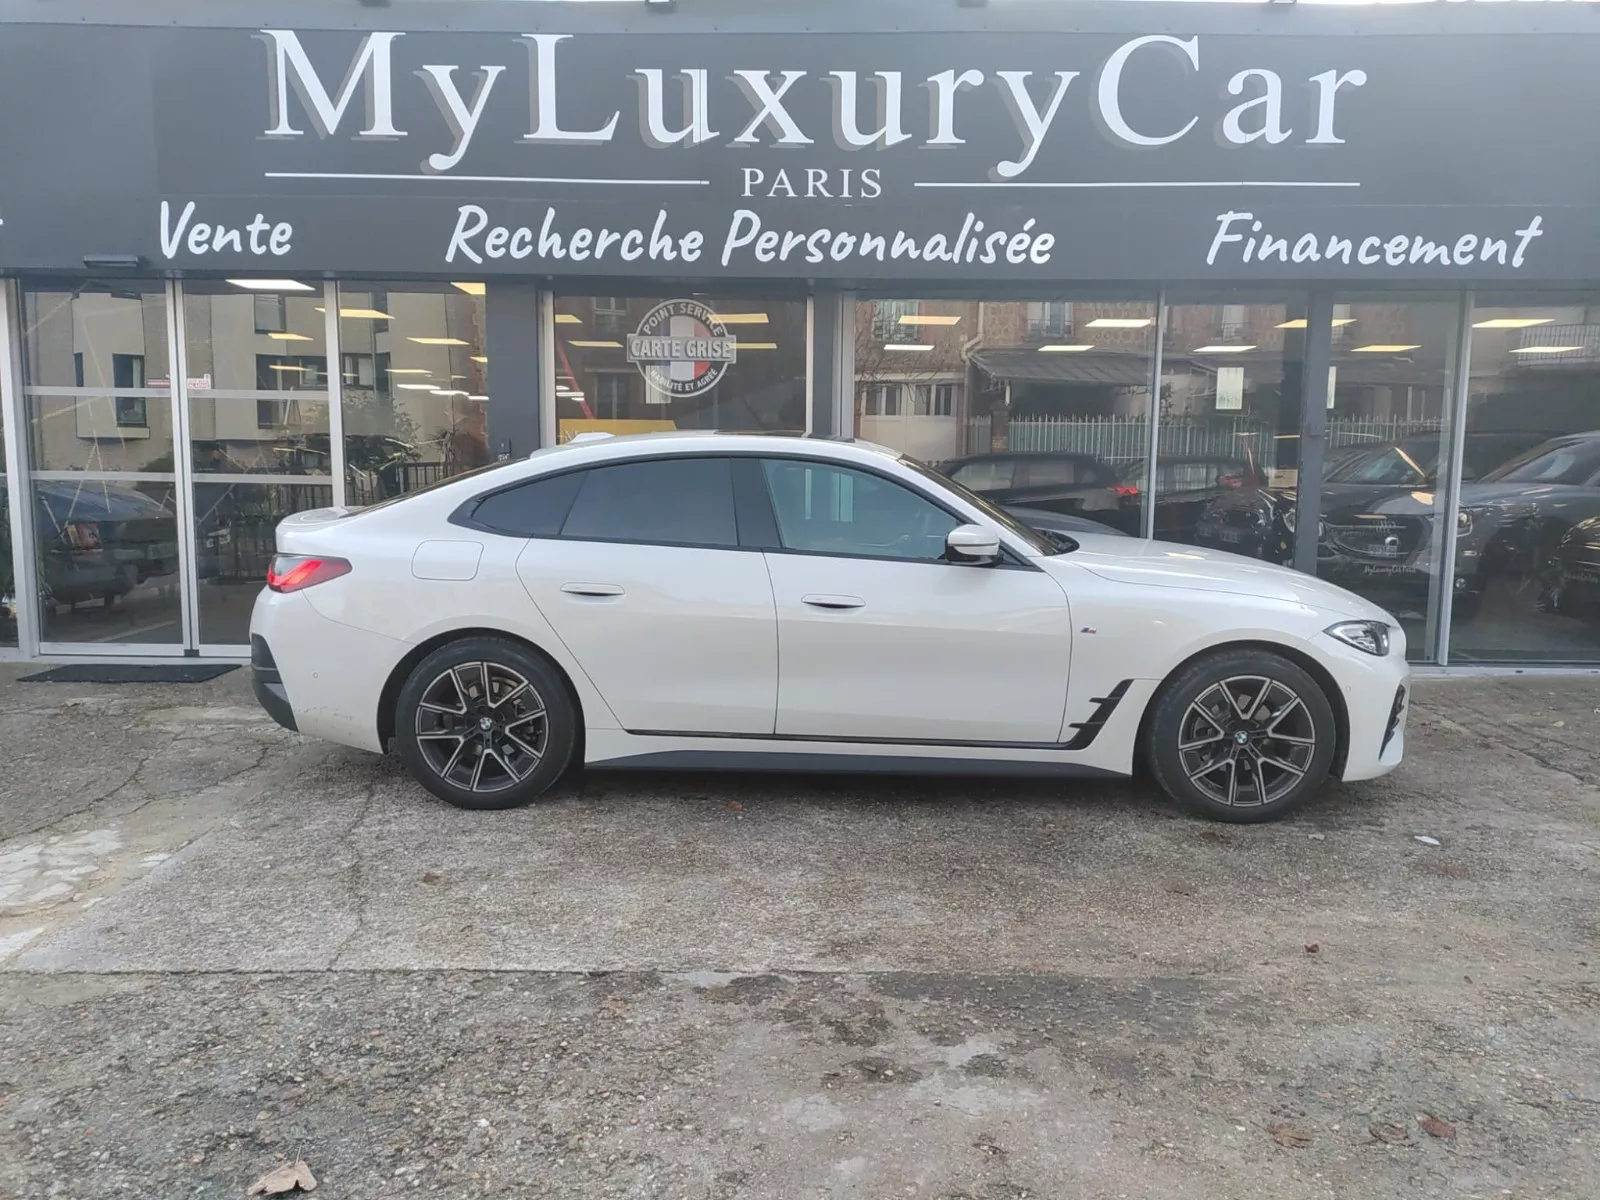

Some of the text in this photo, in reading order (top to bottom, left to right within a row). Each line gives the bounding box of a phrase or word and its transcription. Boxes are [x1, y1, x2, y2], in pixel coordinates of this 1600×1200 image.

[260, 29, 1367, 177] MyLuxuryCar
[741, 168, 882, 198] PARIS
[160, 200, 293, 259] Vente
[445, 204, 1055, 266] Recherche Personnalisée
[1206, 210, 1543, 268] Financement
[643, 303, 723, 336] POINT SERVICE
[631, 339, 732, 358] CARTE GRISE
[650, 370, 683, 391] HABILITÉ
[685, 382, 694, 391] ET
